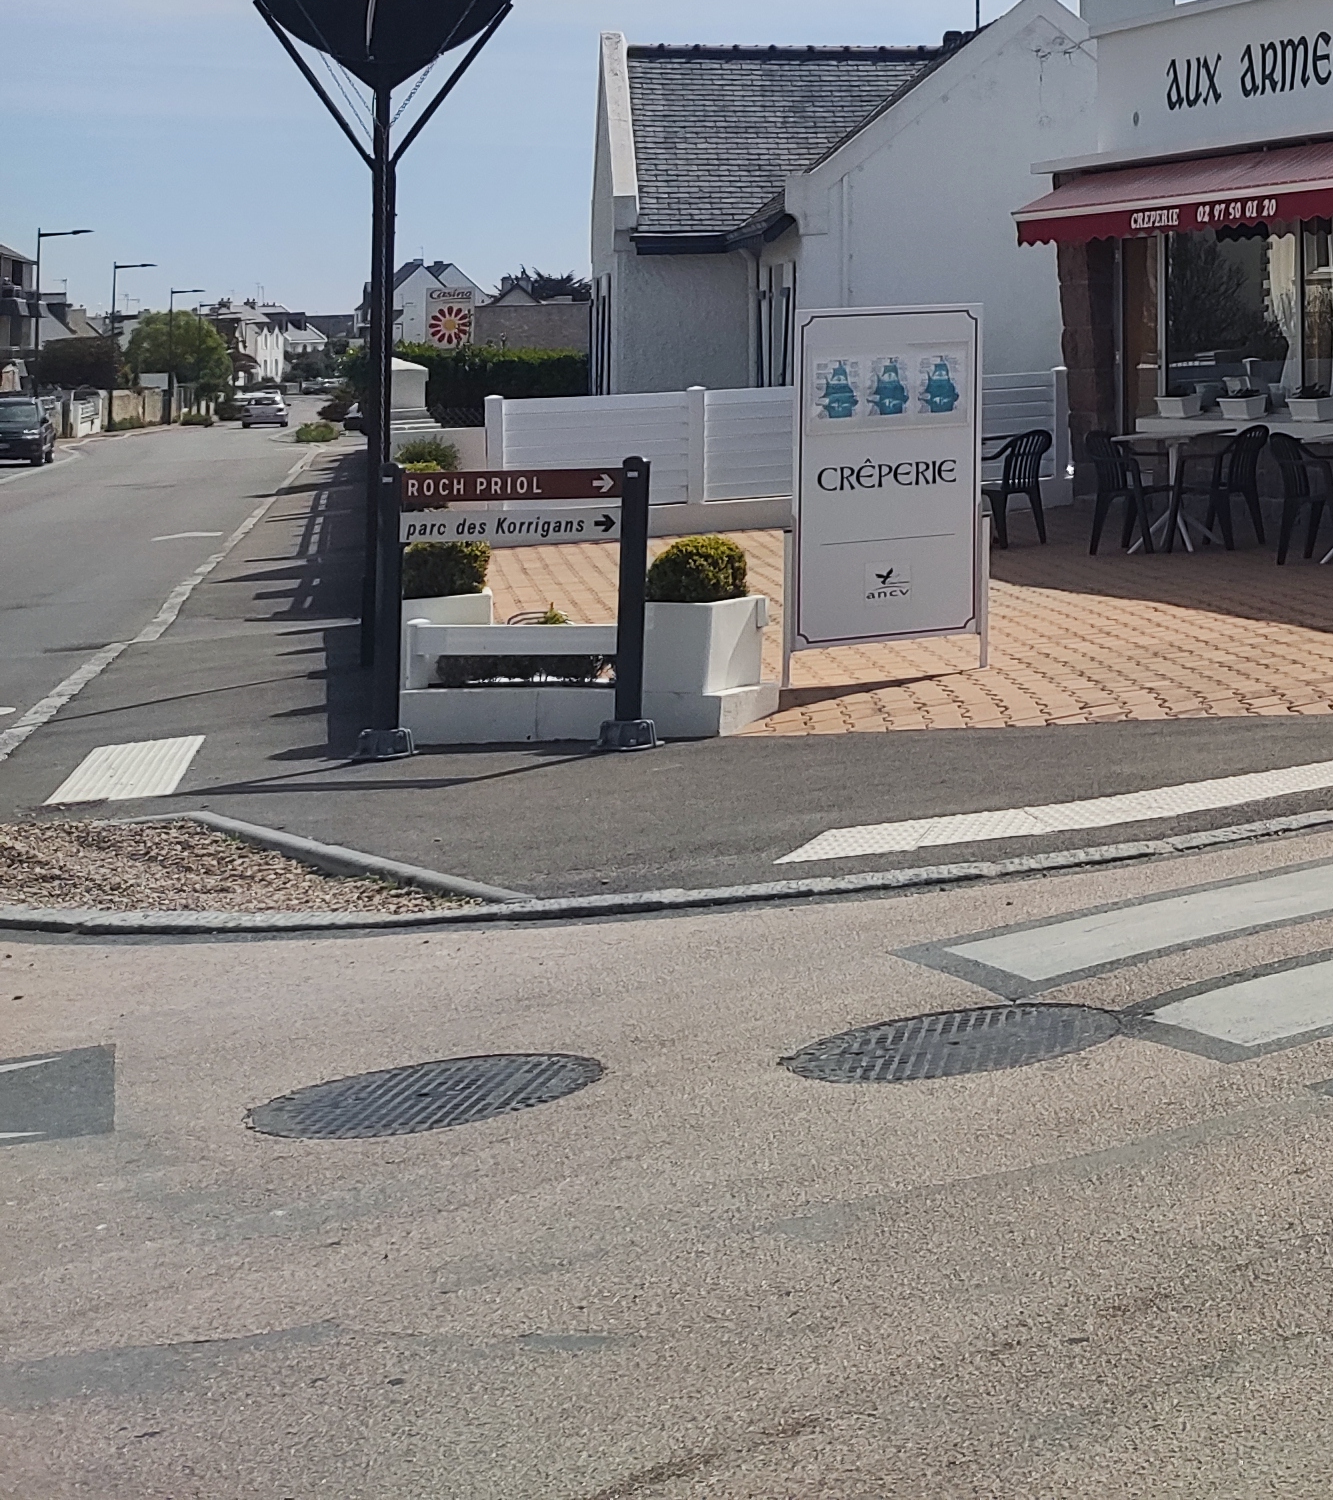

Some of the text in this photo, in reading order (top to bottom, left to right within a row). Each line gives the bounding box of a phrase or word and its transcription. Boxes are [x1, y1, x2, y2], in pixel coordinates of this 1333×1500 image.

[1131, 199, 1276, 229] CREPERIE 02 97 50 01 20
[429, 289, 472, 300] Casino
[407, 476, 543, 496] ROCH PRIOL
[817, 458, 957, 492] CRÊPERIE
[406, 516, 585, 540] parc des Korrigans
[866, 588, 910, 600] ancv
